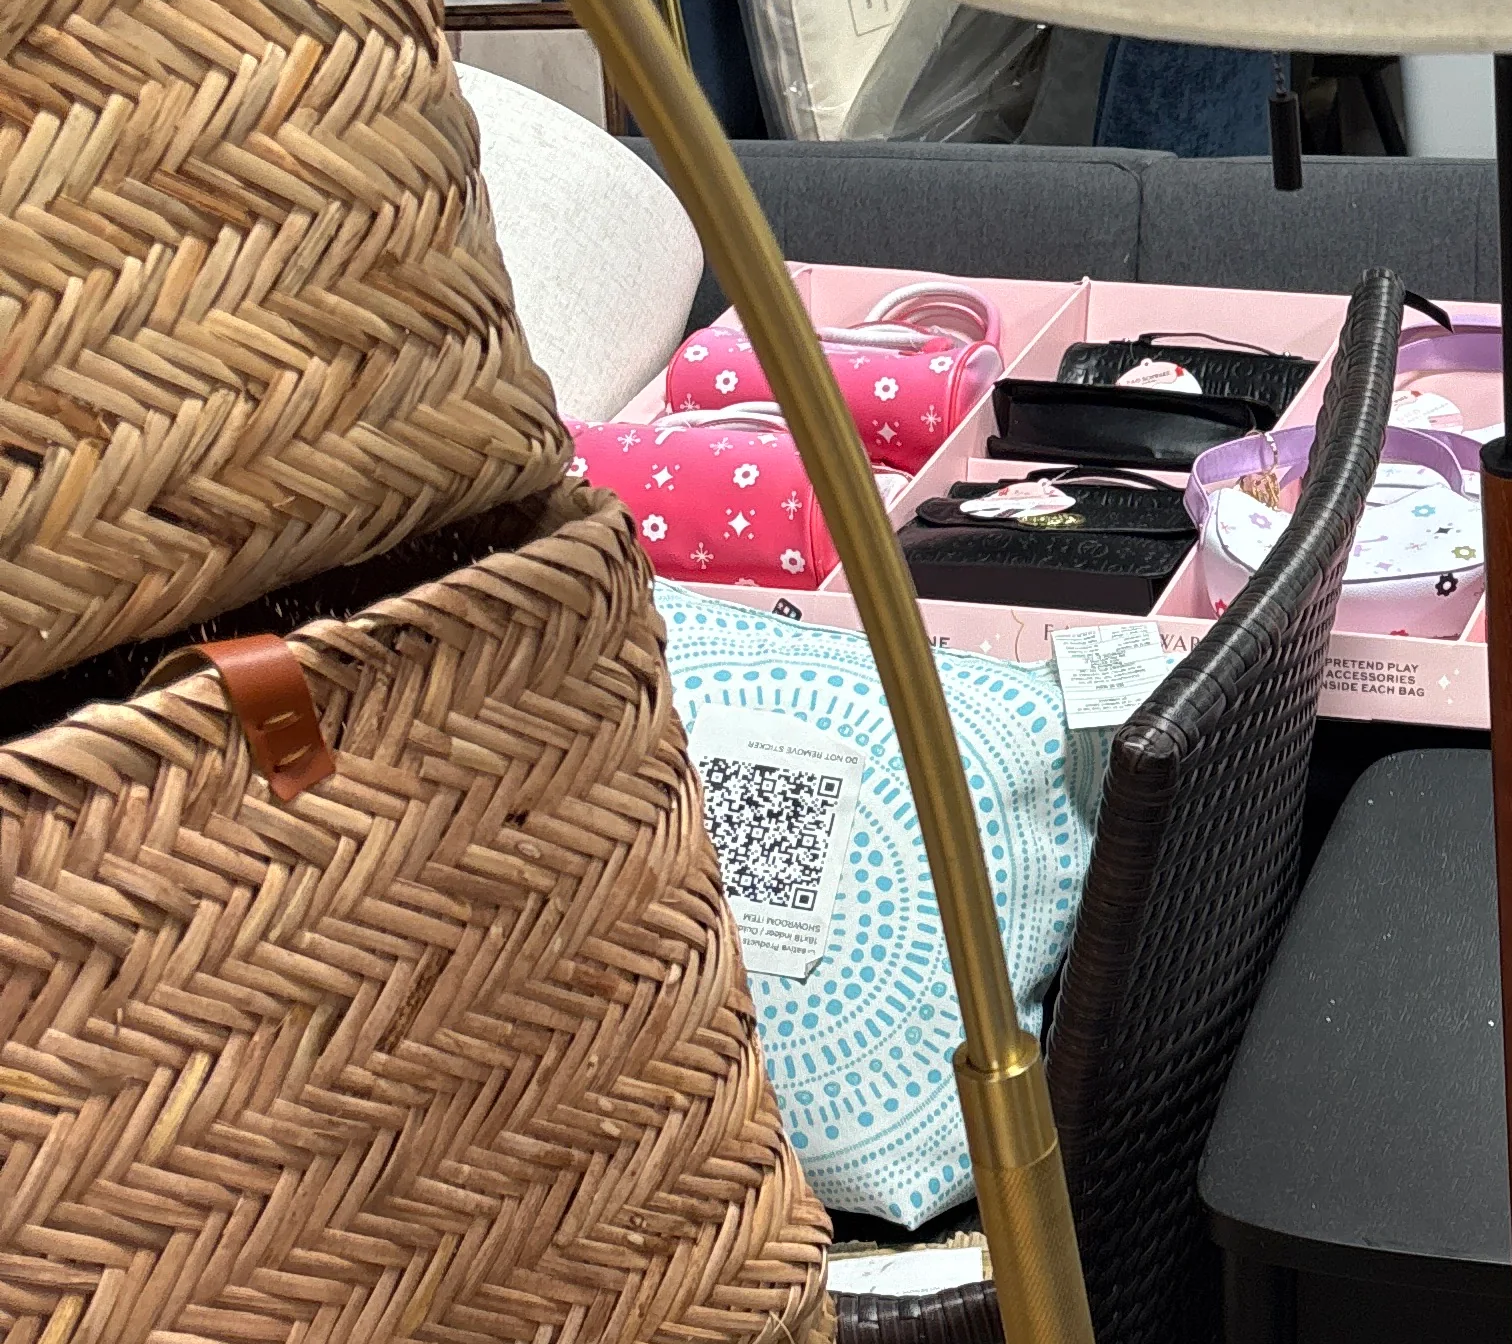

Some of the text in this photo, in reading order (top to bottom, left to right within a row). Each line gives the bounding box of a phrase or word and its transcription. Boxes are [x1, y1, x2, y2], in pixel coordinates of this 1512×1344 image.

[1325, 657, 1420, 674] PRETEND PLAY
[1325, 669, 1416, 685] ACCESSORIES
[1319, 680, 1425, 697] NSIDE EACH BAG
[747, 740, 784, 753] STICKER
[786, 746, 823, 759] REMOVE
[824, 753, 843, 762] NOT
[742, 912, 821, 933] SHOWROOM ITEM
